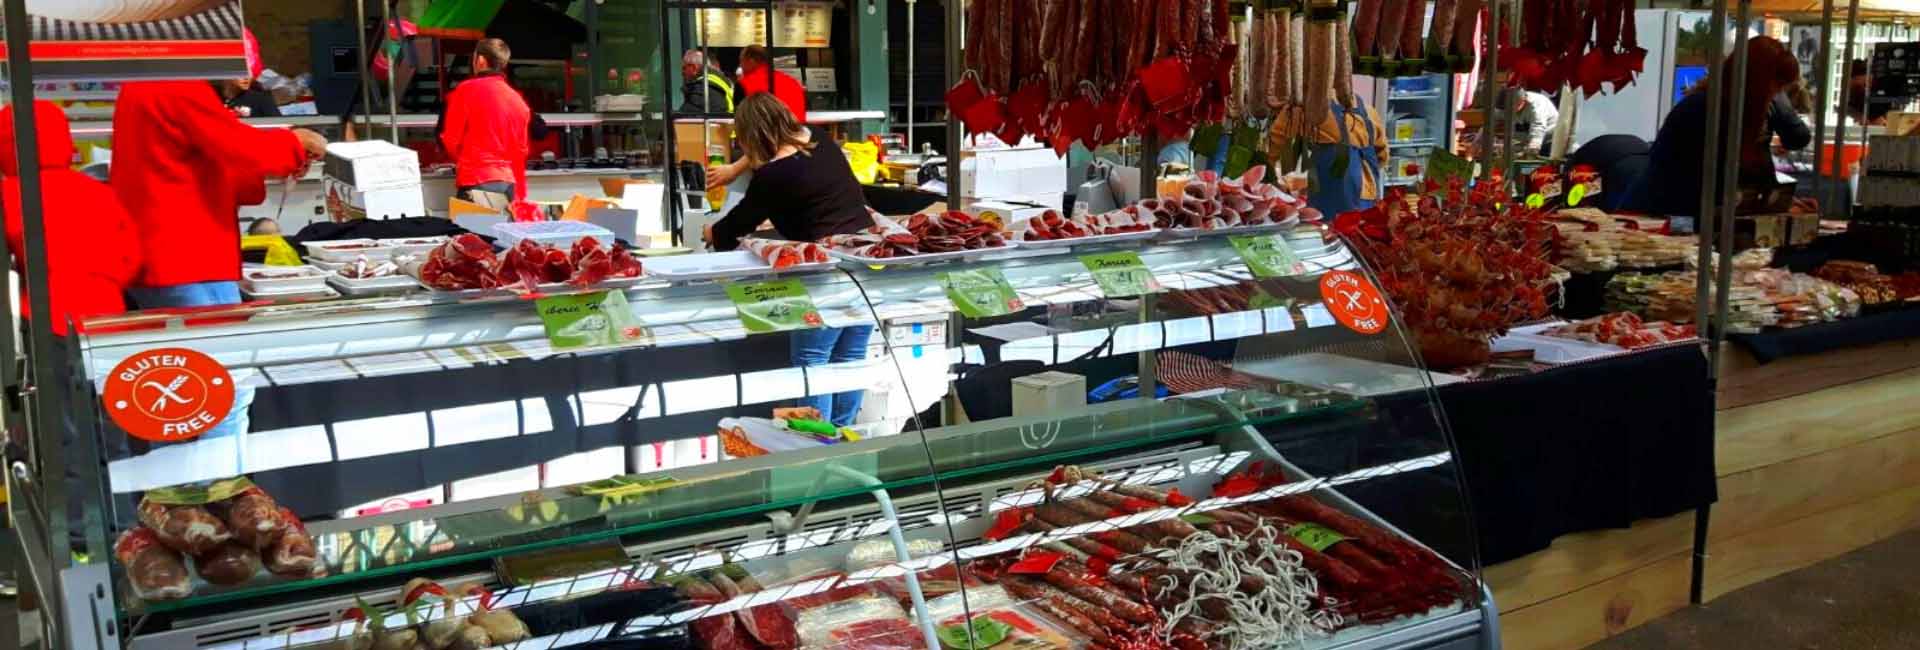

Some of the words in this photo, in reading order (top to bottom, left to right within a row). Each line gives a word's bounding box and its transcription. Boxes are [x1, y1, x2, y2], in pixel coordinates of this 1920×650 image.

[1326, 274, 1359, 288] GLUTEN
[1354, 318, 1381, 330] FREE
[119, 354, 188, 382] GLUTEN
[162, 410, 216, 436] FREE
